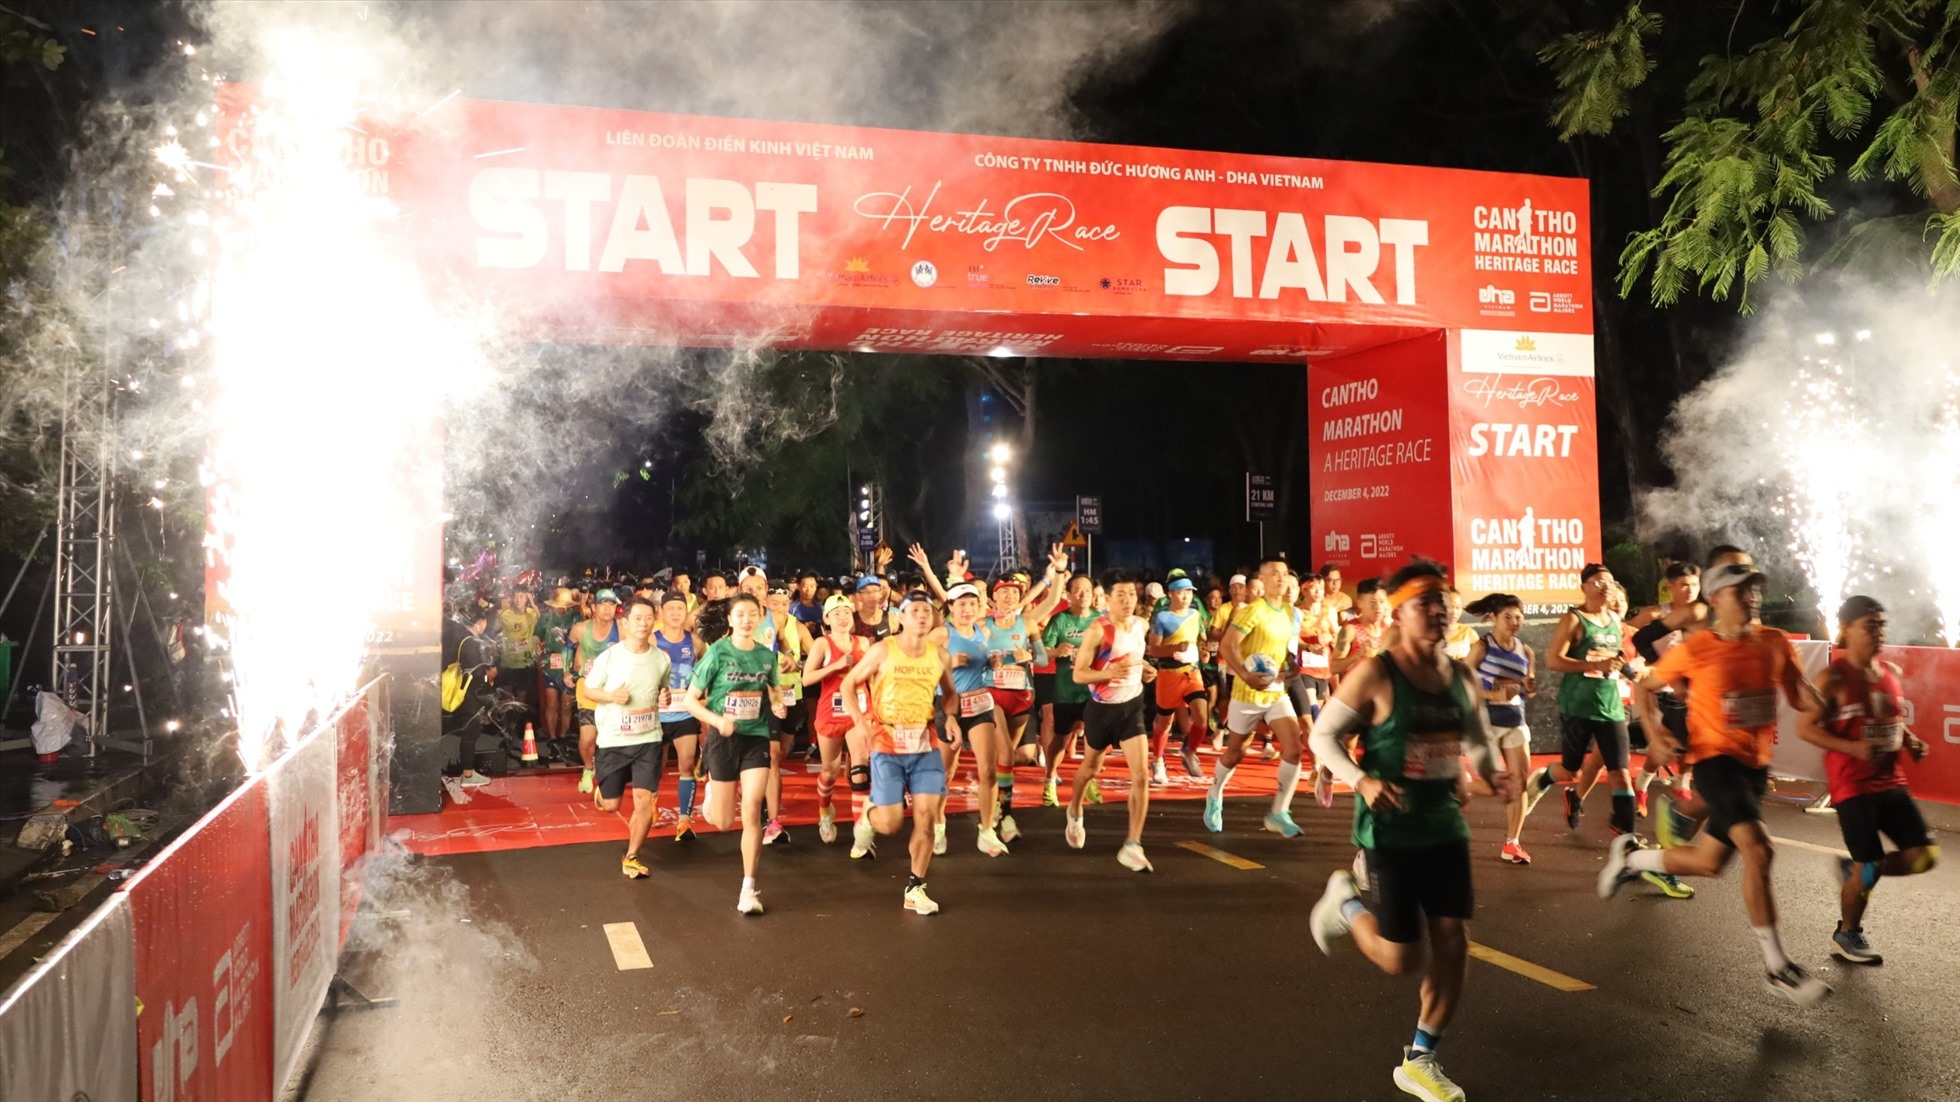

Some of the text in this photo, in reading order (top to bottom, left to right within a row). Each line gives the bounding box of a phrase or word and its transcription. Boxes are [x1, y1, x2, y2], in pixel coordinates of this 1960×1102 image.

[606, 130, 645, 147] LIÊN
[650, 131, 701, 150] ĐOÀN
[750, 140, 792, 156] KINH
[795, 141, 831, 161] VIỆT
[835, 146, 875, 160] NAM
[974, 152, 1020, 170] CÔNG
[1021, 158, 1040, 171] TY
[1044, 158, 1087, 174] TNHH
[1090, 160, 1122, 177] ĐỨC
[1126, 164, 1181, 181] HƯƠNG
[1184, 168, 1216, 182] ANH
[1226, 171, 1258, 186] DHA
[1260, 174, 1324, 190] VIETNAM
[469, 167, 818, 280] START
[854, 180, 1121, 252] Heritage Race
[1474, 206, 1577, 234] CAN THO
[1155, 206, 1429, 306] START
[1474, 232, 1578, 257] MARATHON
[968, 273, 988, 282] true
[1474, 255, 1578, 275] HERITAGE RACE
[1116, 278, 1142, 286] STAR
[1322, 378, 1378, 408] CANTHO
[1464, 373, 1579, 408] Heritage Race
[1323, 408, 1403, 442] MARATHON
[1468, 422, 1579, 458] START
[1324, 438, 1432, 473] A HERITAGE RACE
[1251, 490, 1274, 501] 21 KM
[1324, 485, 1390, 502] DECEMBER 4, 2022
[1080, 516, 1098, 524] 1:45
[1471, 518, 1584, 545] CAN THO
[1472, 548, 1585, 571] MARATHON
[1472, 573, 1544, 592] HERITAGE
[634, 713, 652, 724] 21978
